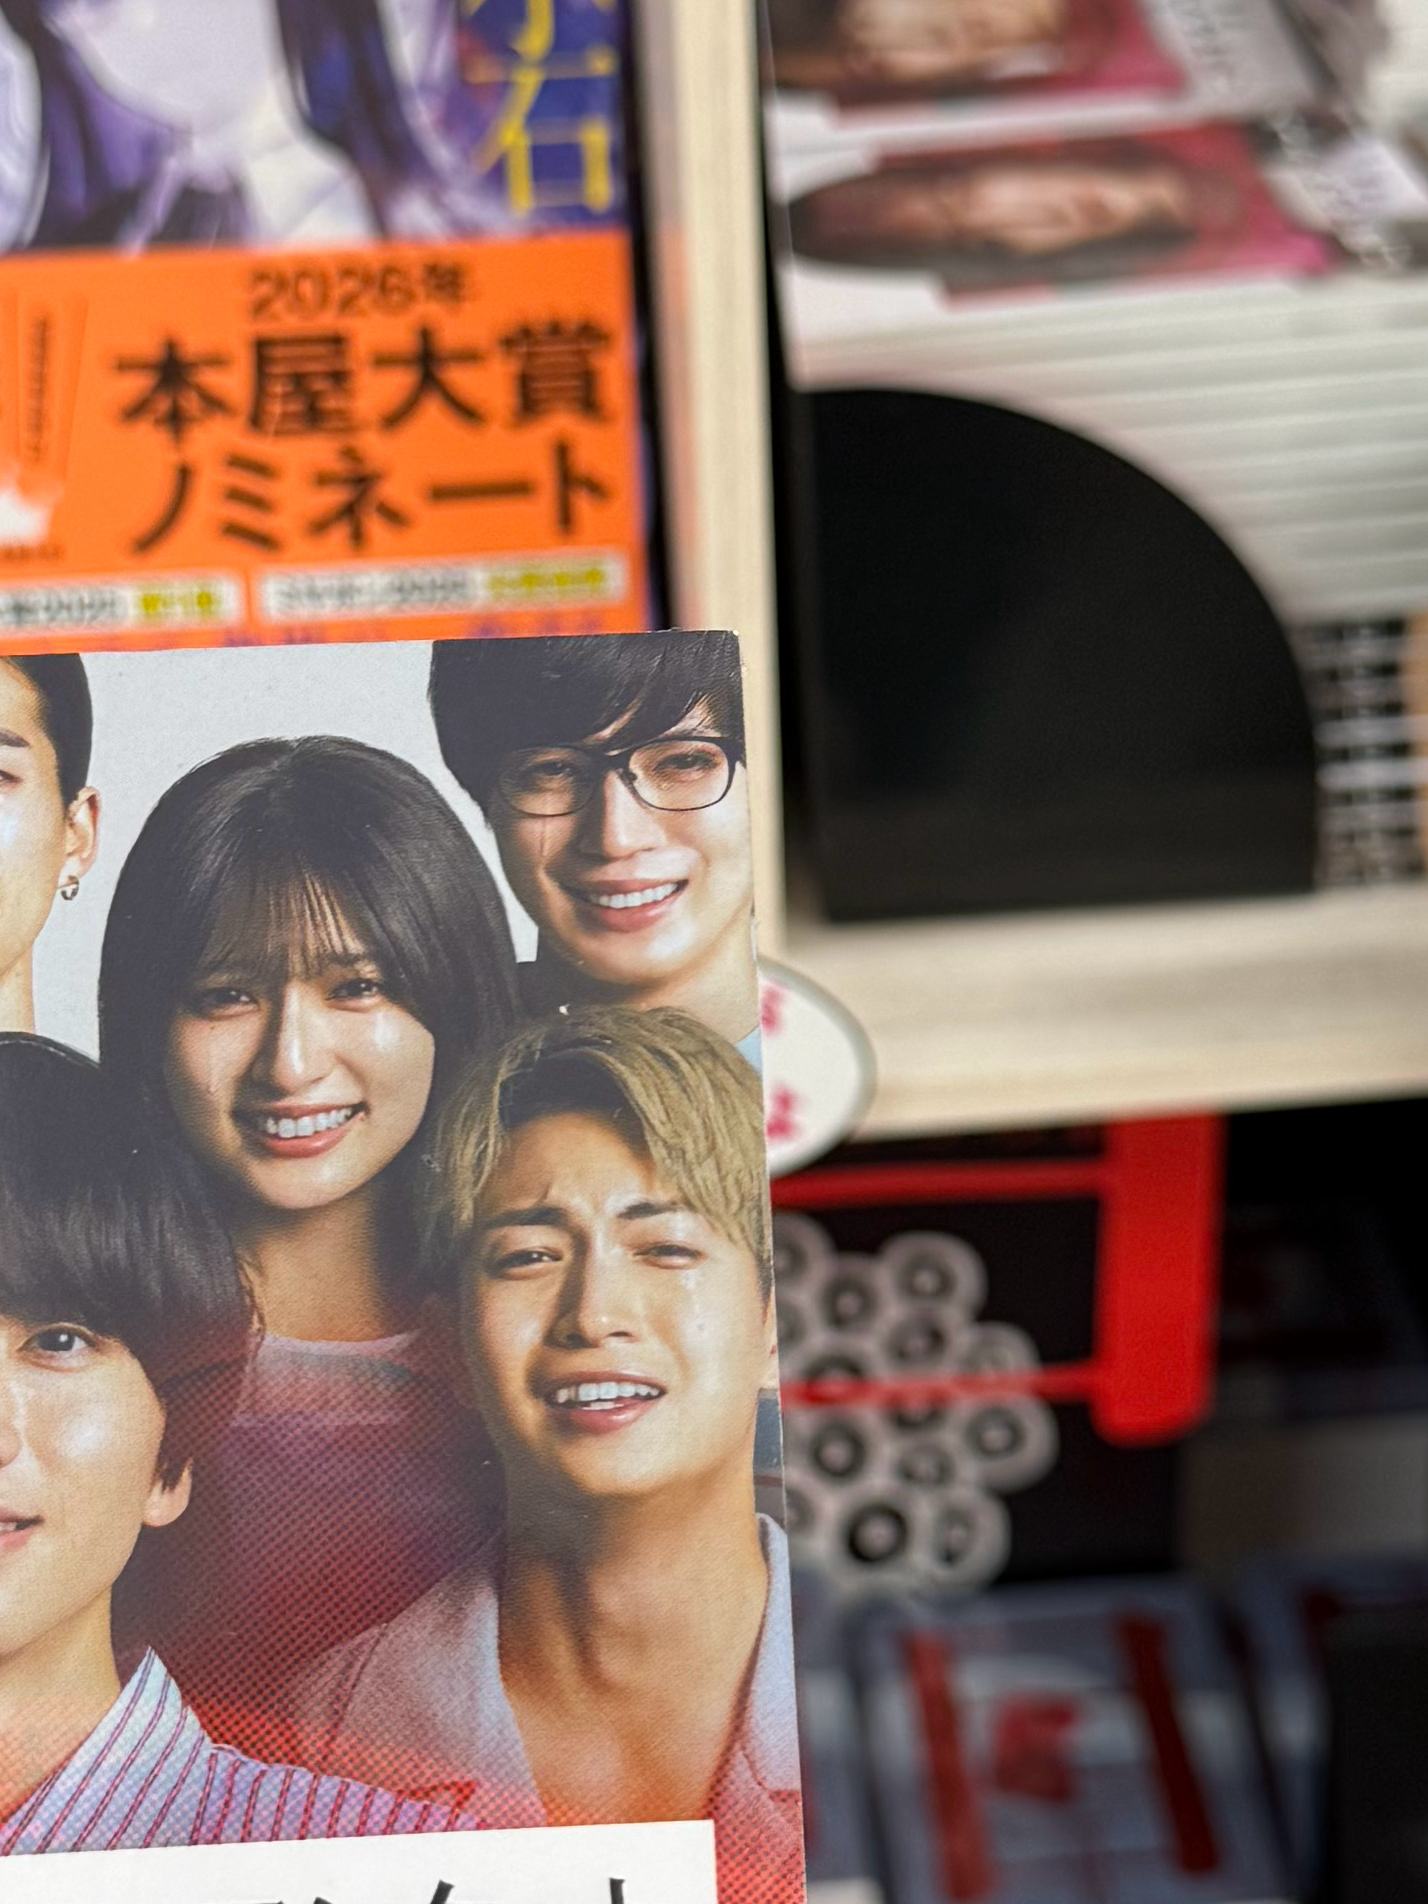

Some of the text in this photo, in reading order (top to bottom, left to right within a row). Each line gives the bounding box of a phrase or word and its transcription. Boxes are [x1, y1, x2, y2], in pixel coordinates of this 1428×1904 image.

[246, 260, 474, 322] 2026年
[110, 314, 614, 441] 本屋大賞
[130, 441, 612, 556] ノミネート
